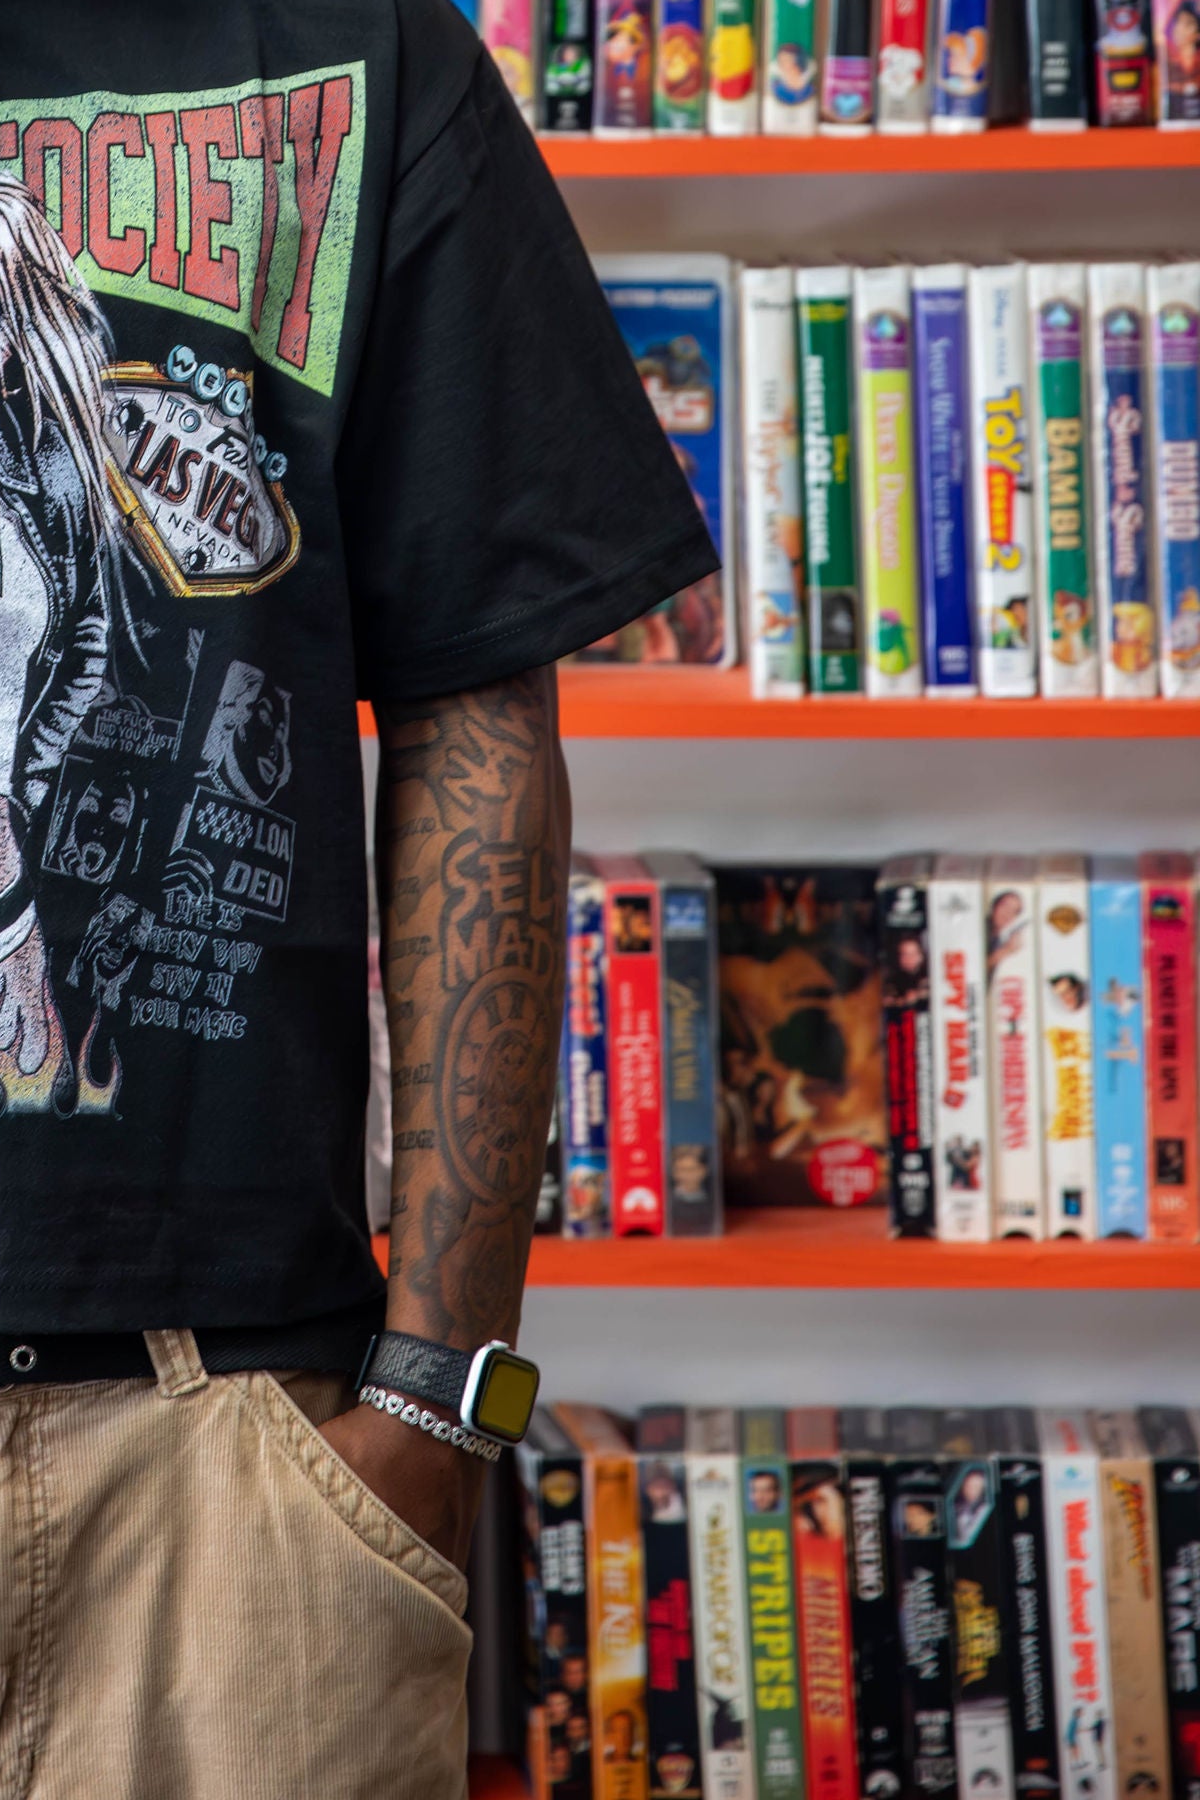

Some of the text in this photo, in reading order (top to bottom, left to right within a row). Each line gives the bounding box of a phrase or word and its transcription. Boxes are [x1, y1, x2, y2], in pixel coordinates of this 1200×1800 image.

[929, 335, 953, 388] SNOW
[165, 394, 201, 432] TO
[931, 392, 957, 454] WHITE
[984, 388, 1024, 470] TOY
[126, 420, 203, 504] LAS
[804, 356, 832, 565] MIGHTY JOE YOUNG
[1047, 417, 1082, 551] BAMBI
[1163, 439, 1199, 542] DUMBO
[167, 510, 243, 565] NEVADA
[868, 474, 906, 569] DRAGON
[986, 468, 1020, 573] STORY 2
[99, 722, 180, 750] DID YOU JUST
[101, 709, 156, 732] THE FUCK
[120, 739, 135, 752] TO
[253, 818, 290, 862] LOA
[221, 859, 286, 909] DED
[445, 836, 554, 918] SEL
[164, 886, 245, 932] LIFE IS
[211, 938, 263, 974] BABY
[445, 916, 553, 989] MAD
[944, 950, 965, 1011] SPY
[150, 961, 235, 1007] STAY IN
[128, 995, 248, 1041] YOUR MAGIC
[602, 1540, 629, 1596] THE
[706, 1529, 732, 1605] WIZARD
[1064, 1500, 1095, 1634] What about
[749, 1529, 796, 1711] STRIPES
[1013, 1533, 1045, 1731] BEING JOHN MALKOVICH
